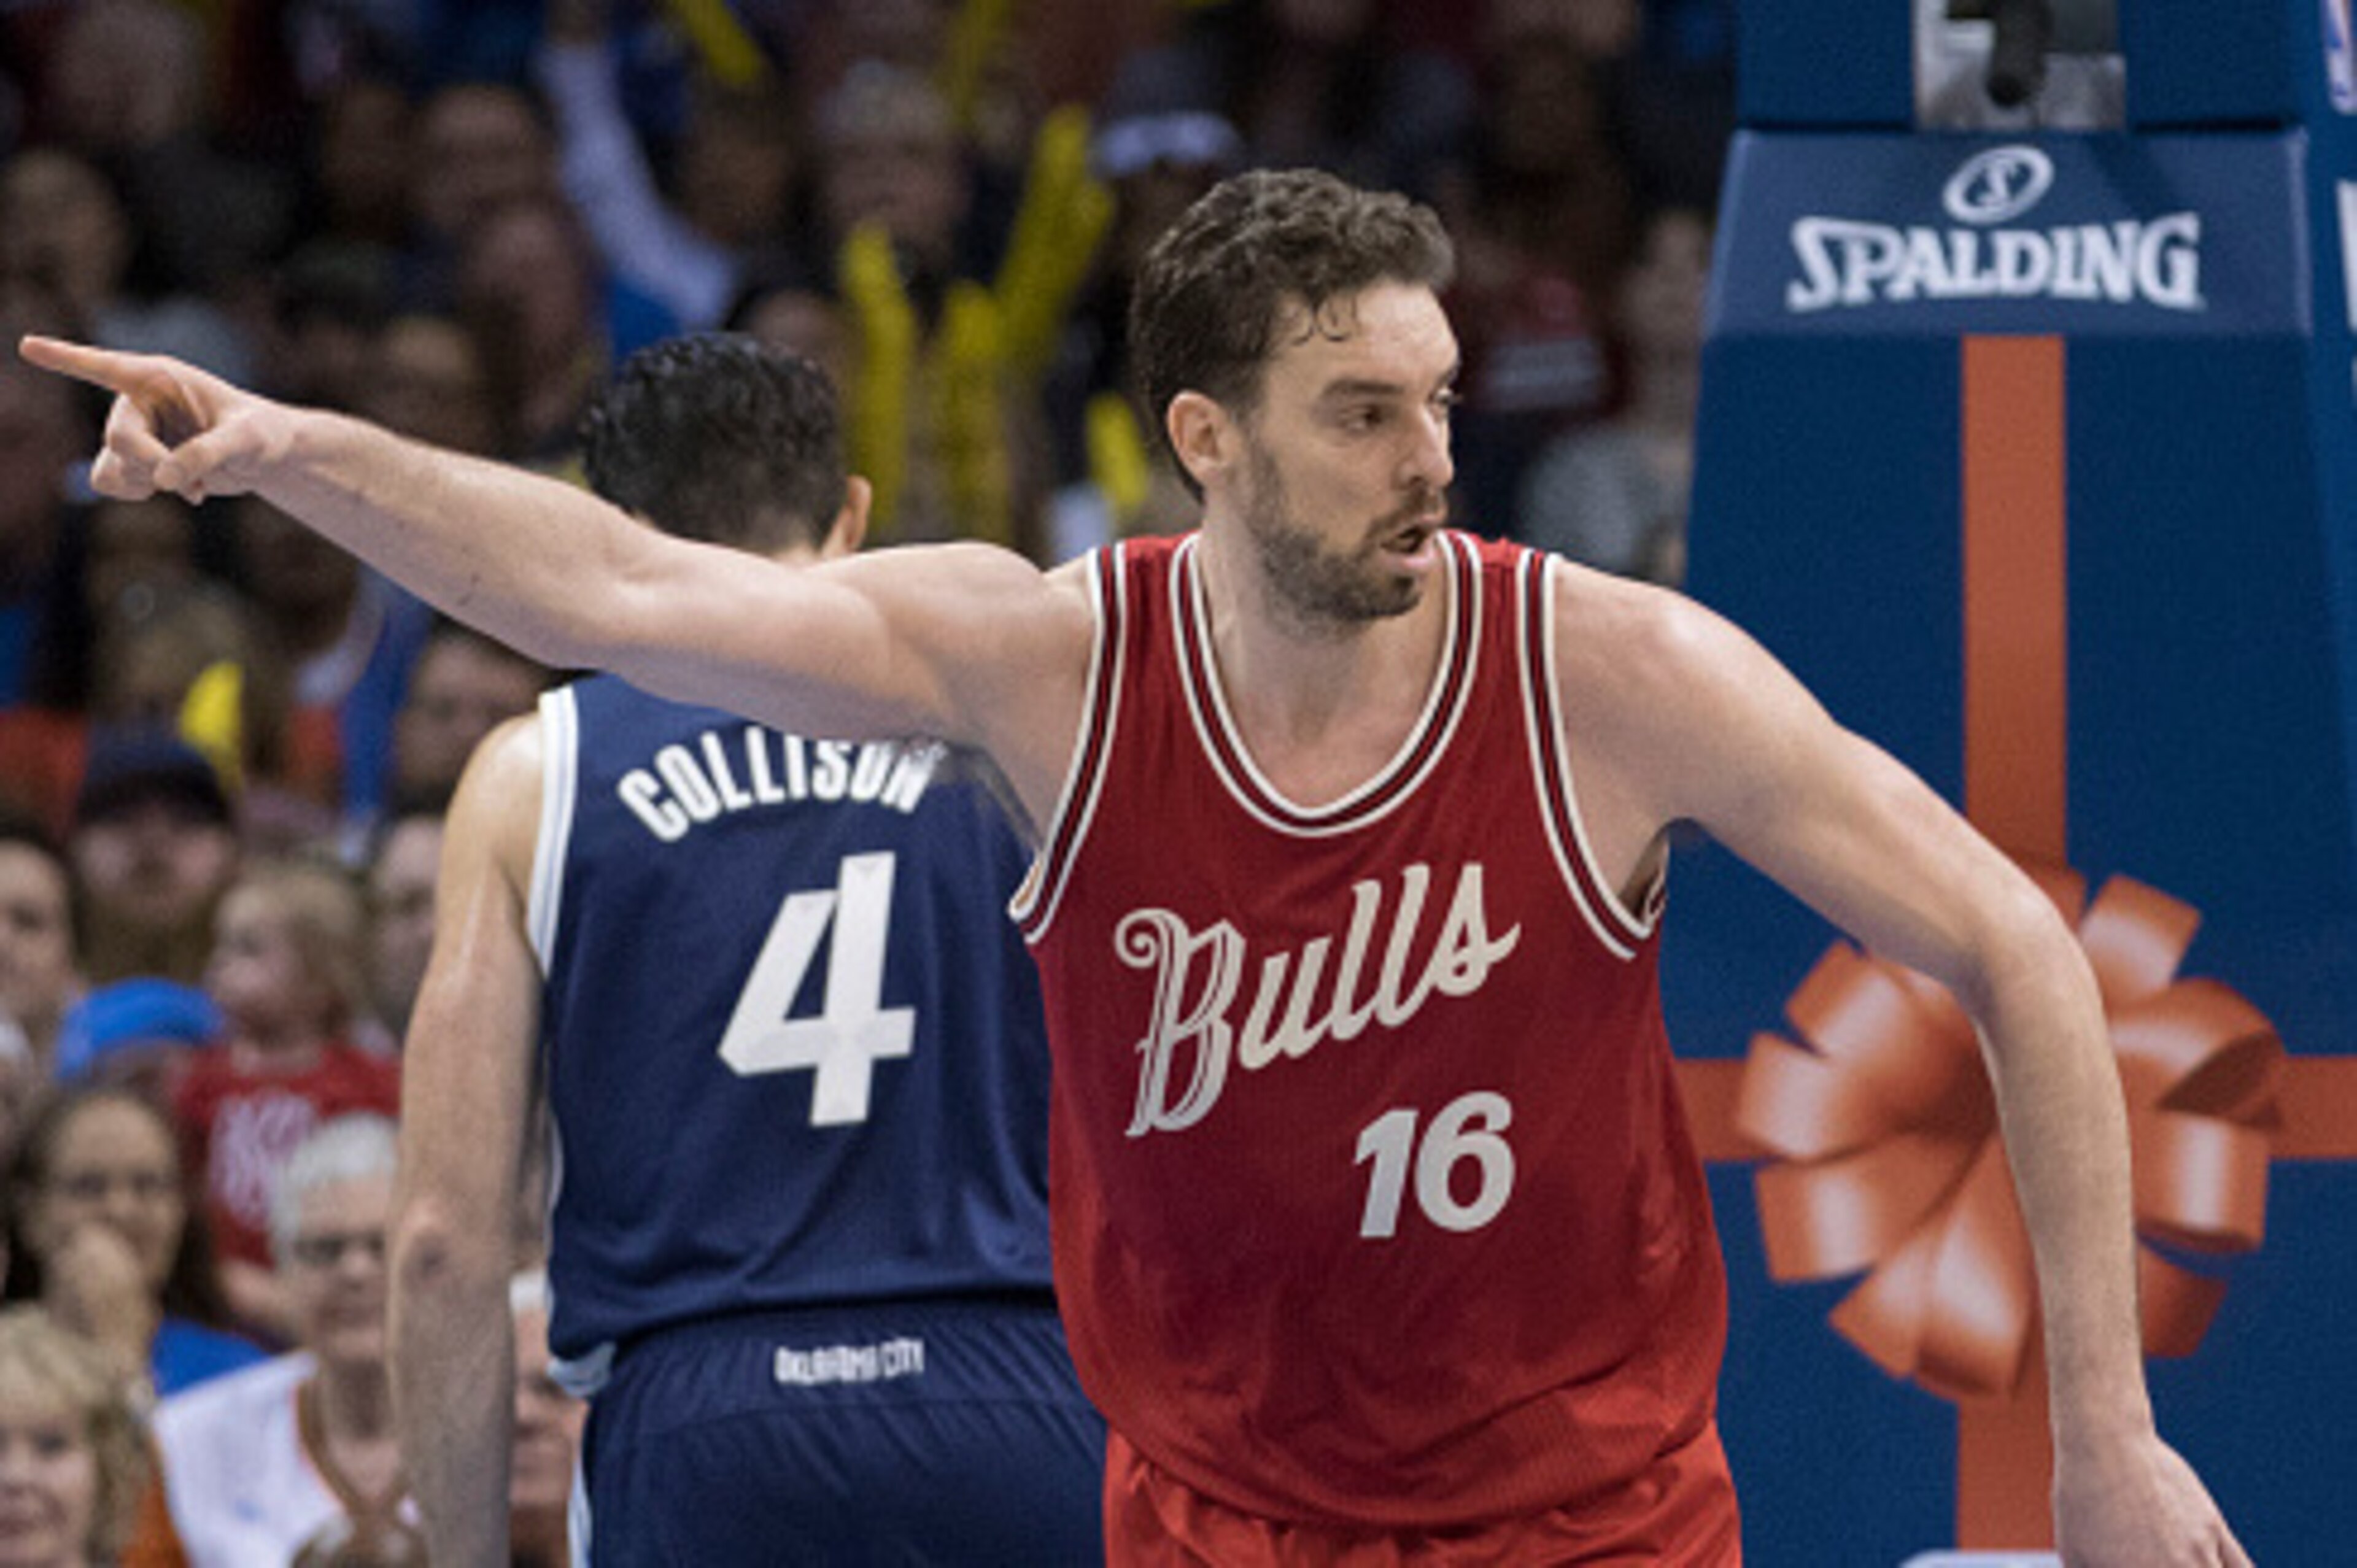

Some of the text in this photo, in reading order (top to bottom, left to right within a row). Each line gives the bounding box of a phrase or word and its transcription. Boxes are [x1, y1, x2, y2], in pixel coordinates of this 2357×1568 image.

[1785, 212, 2205, 312] SPALDING
[617, 726, 948, 842] COLLISON
[717, 850, 916, 1127] 4
[1114, 862, 1522, 1137] Bulls
[1353, 1091, 1516, 1238] 16
